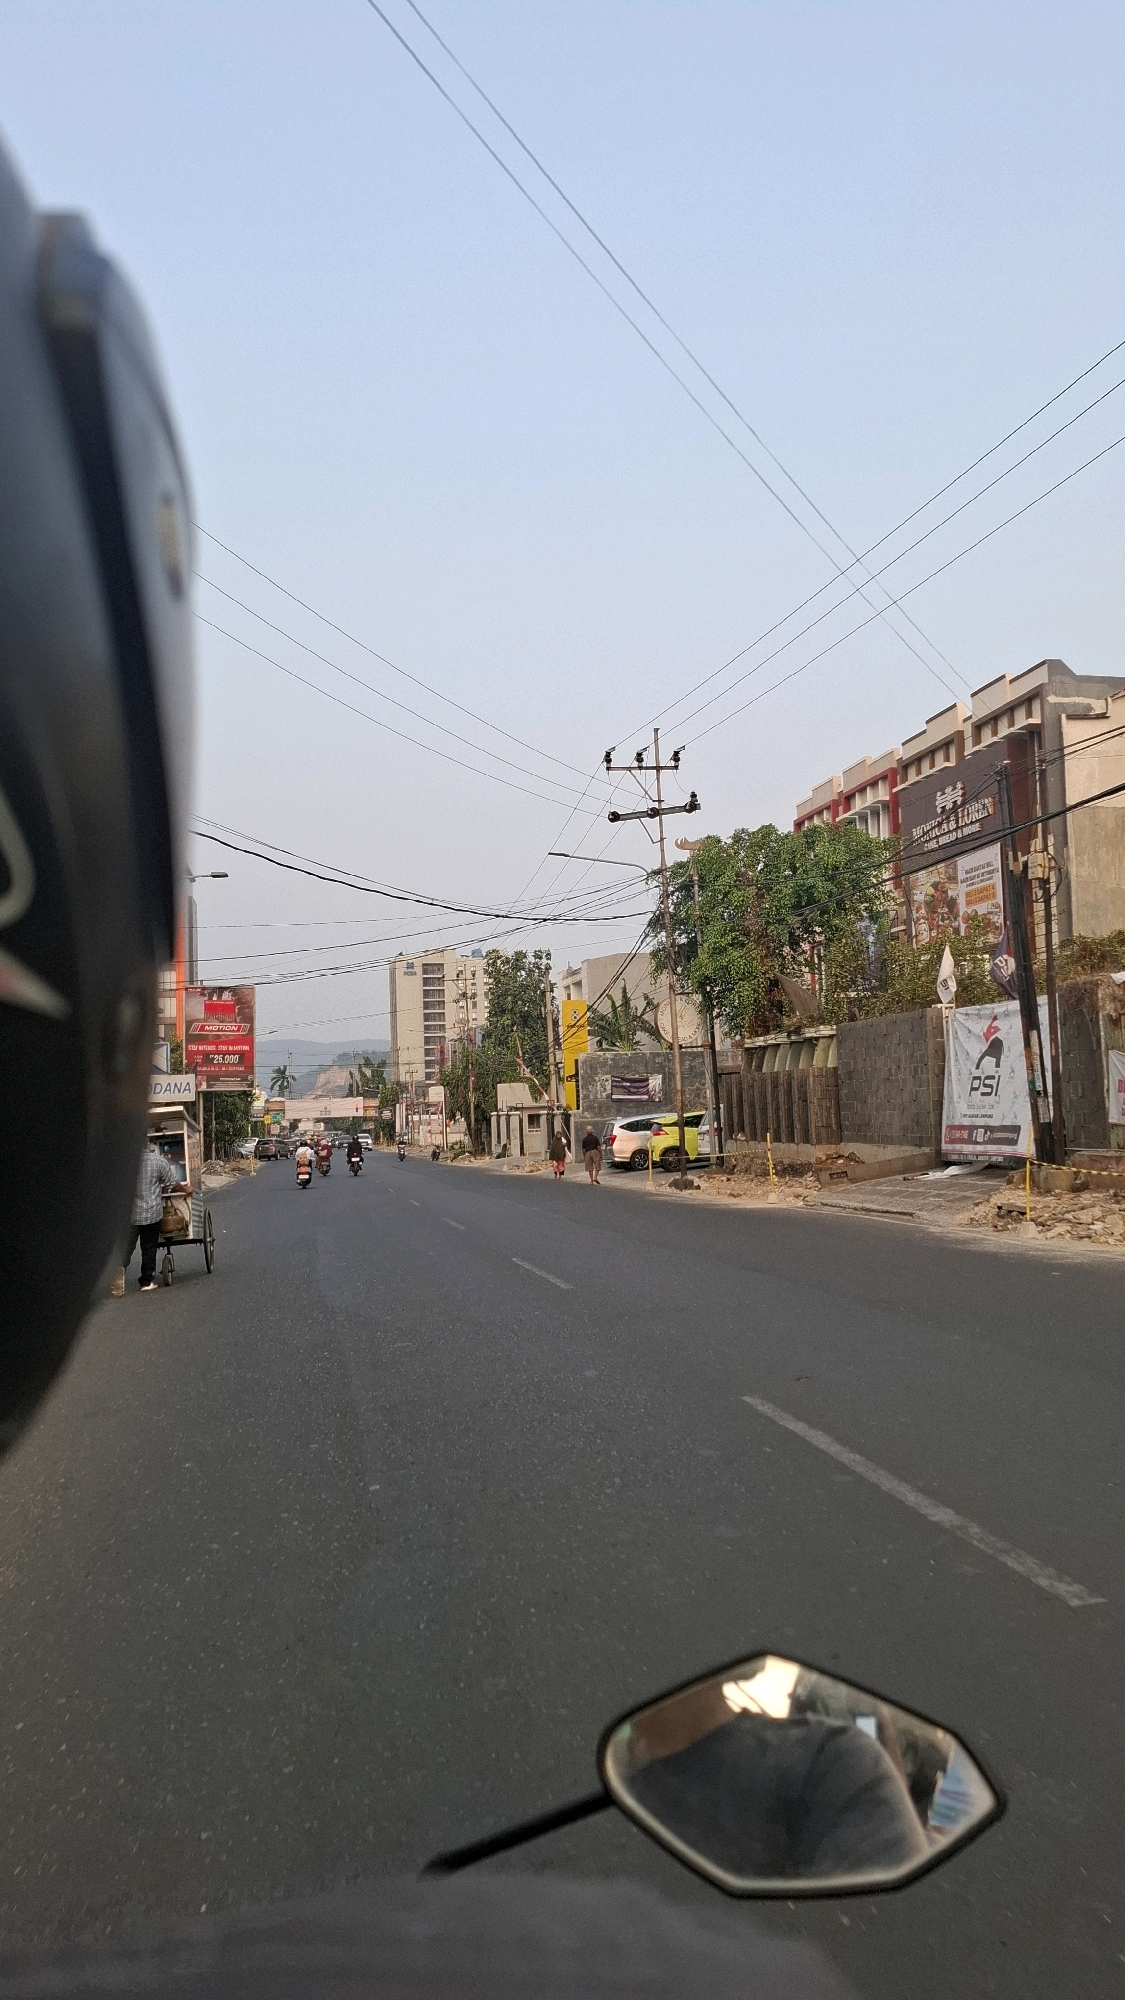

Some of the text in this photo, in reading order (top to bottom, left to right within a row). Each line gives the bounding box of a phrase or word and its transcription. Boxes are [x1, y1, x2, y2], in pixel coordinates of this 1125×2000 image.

[912, 796, 995, 846] MONICA & LOREN
[938, 832, 957, 846] BREAD
[963, 823, 983, 836] MORE
[151, 1082, 191, 1095] DANA
[969, 1074, 1001, 1097] PSI
